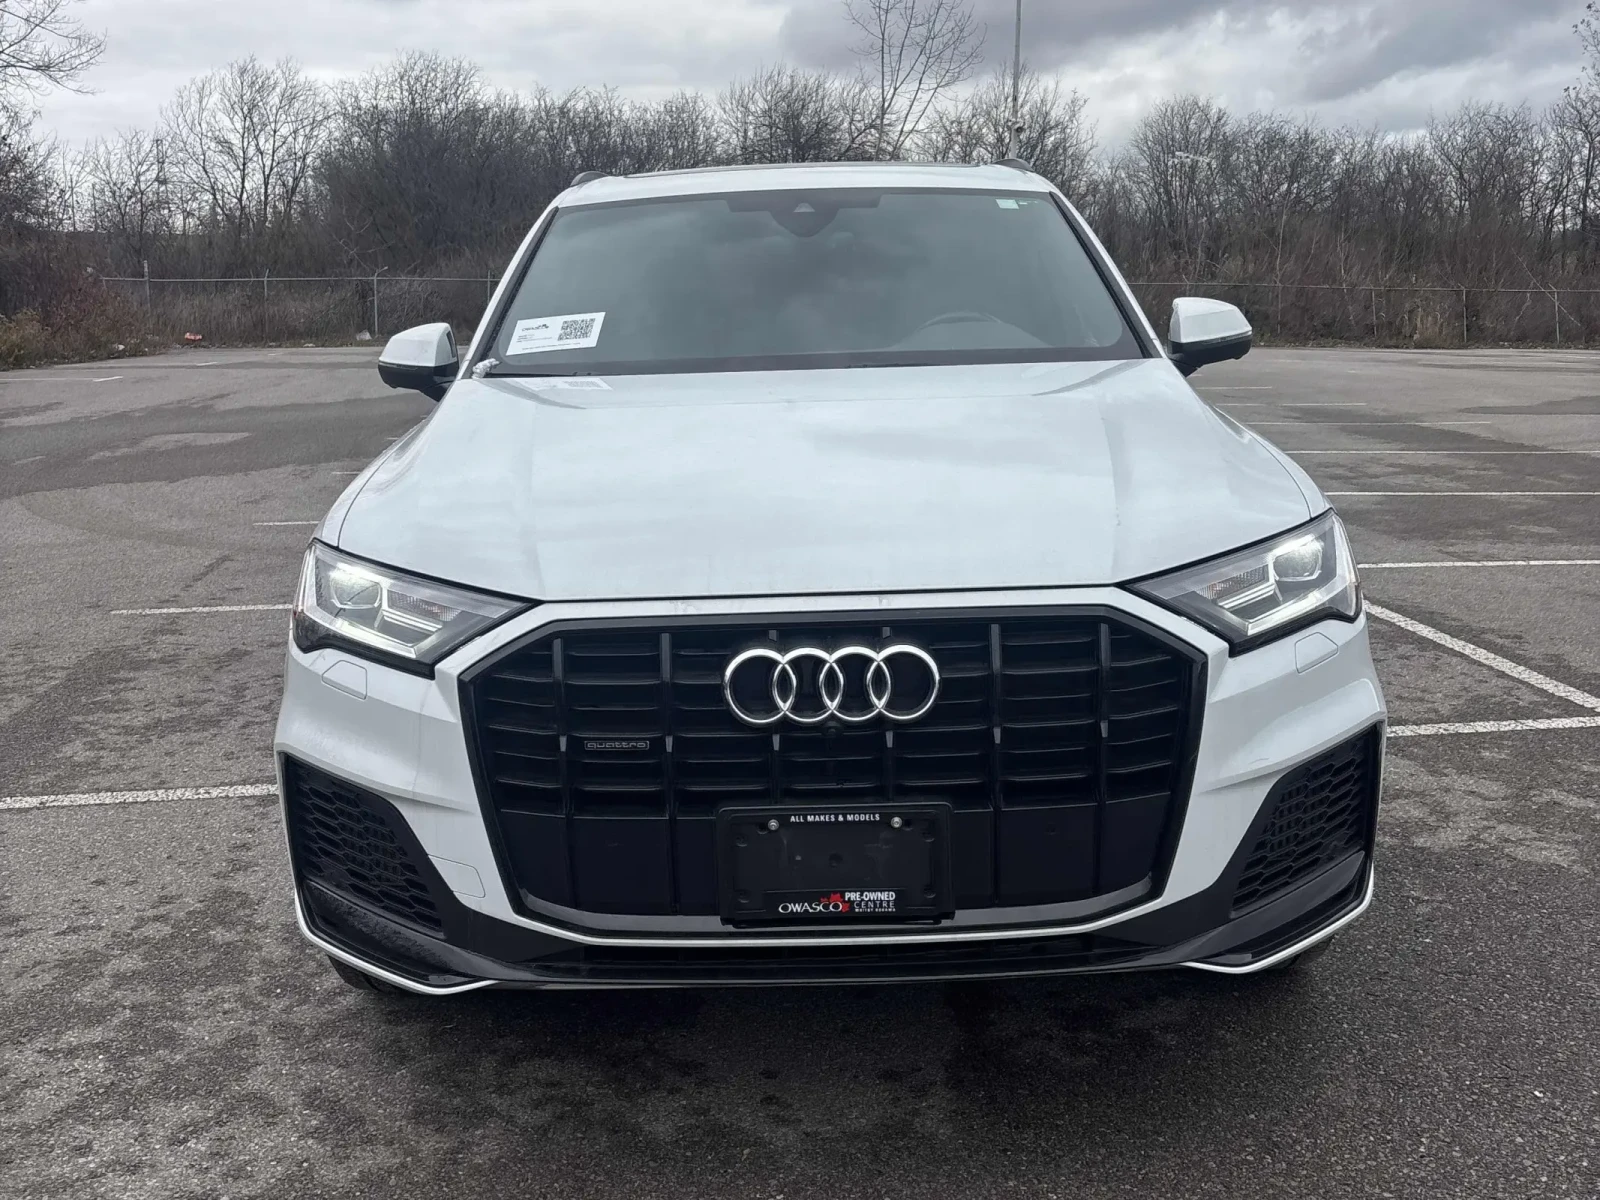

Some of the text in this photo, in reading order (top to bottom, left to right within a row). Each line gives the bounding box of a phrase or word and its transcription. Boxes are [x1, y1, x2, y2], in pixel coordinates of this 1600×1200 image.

[807, 814, 835, 822] MAKES
[846, 813, 880, 821] MODELS
[844, 891, 896, 901] PRE-OWNED
[778, 901, 843, 914] OWASCO
[853, 901, 895, 909] CENTRE
